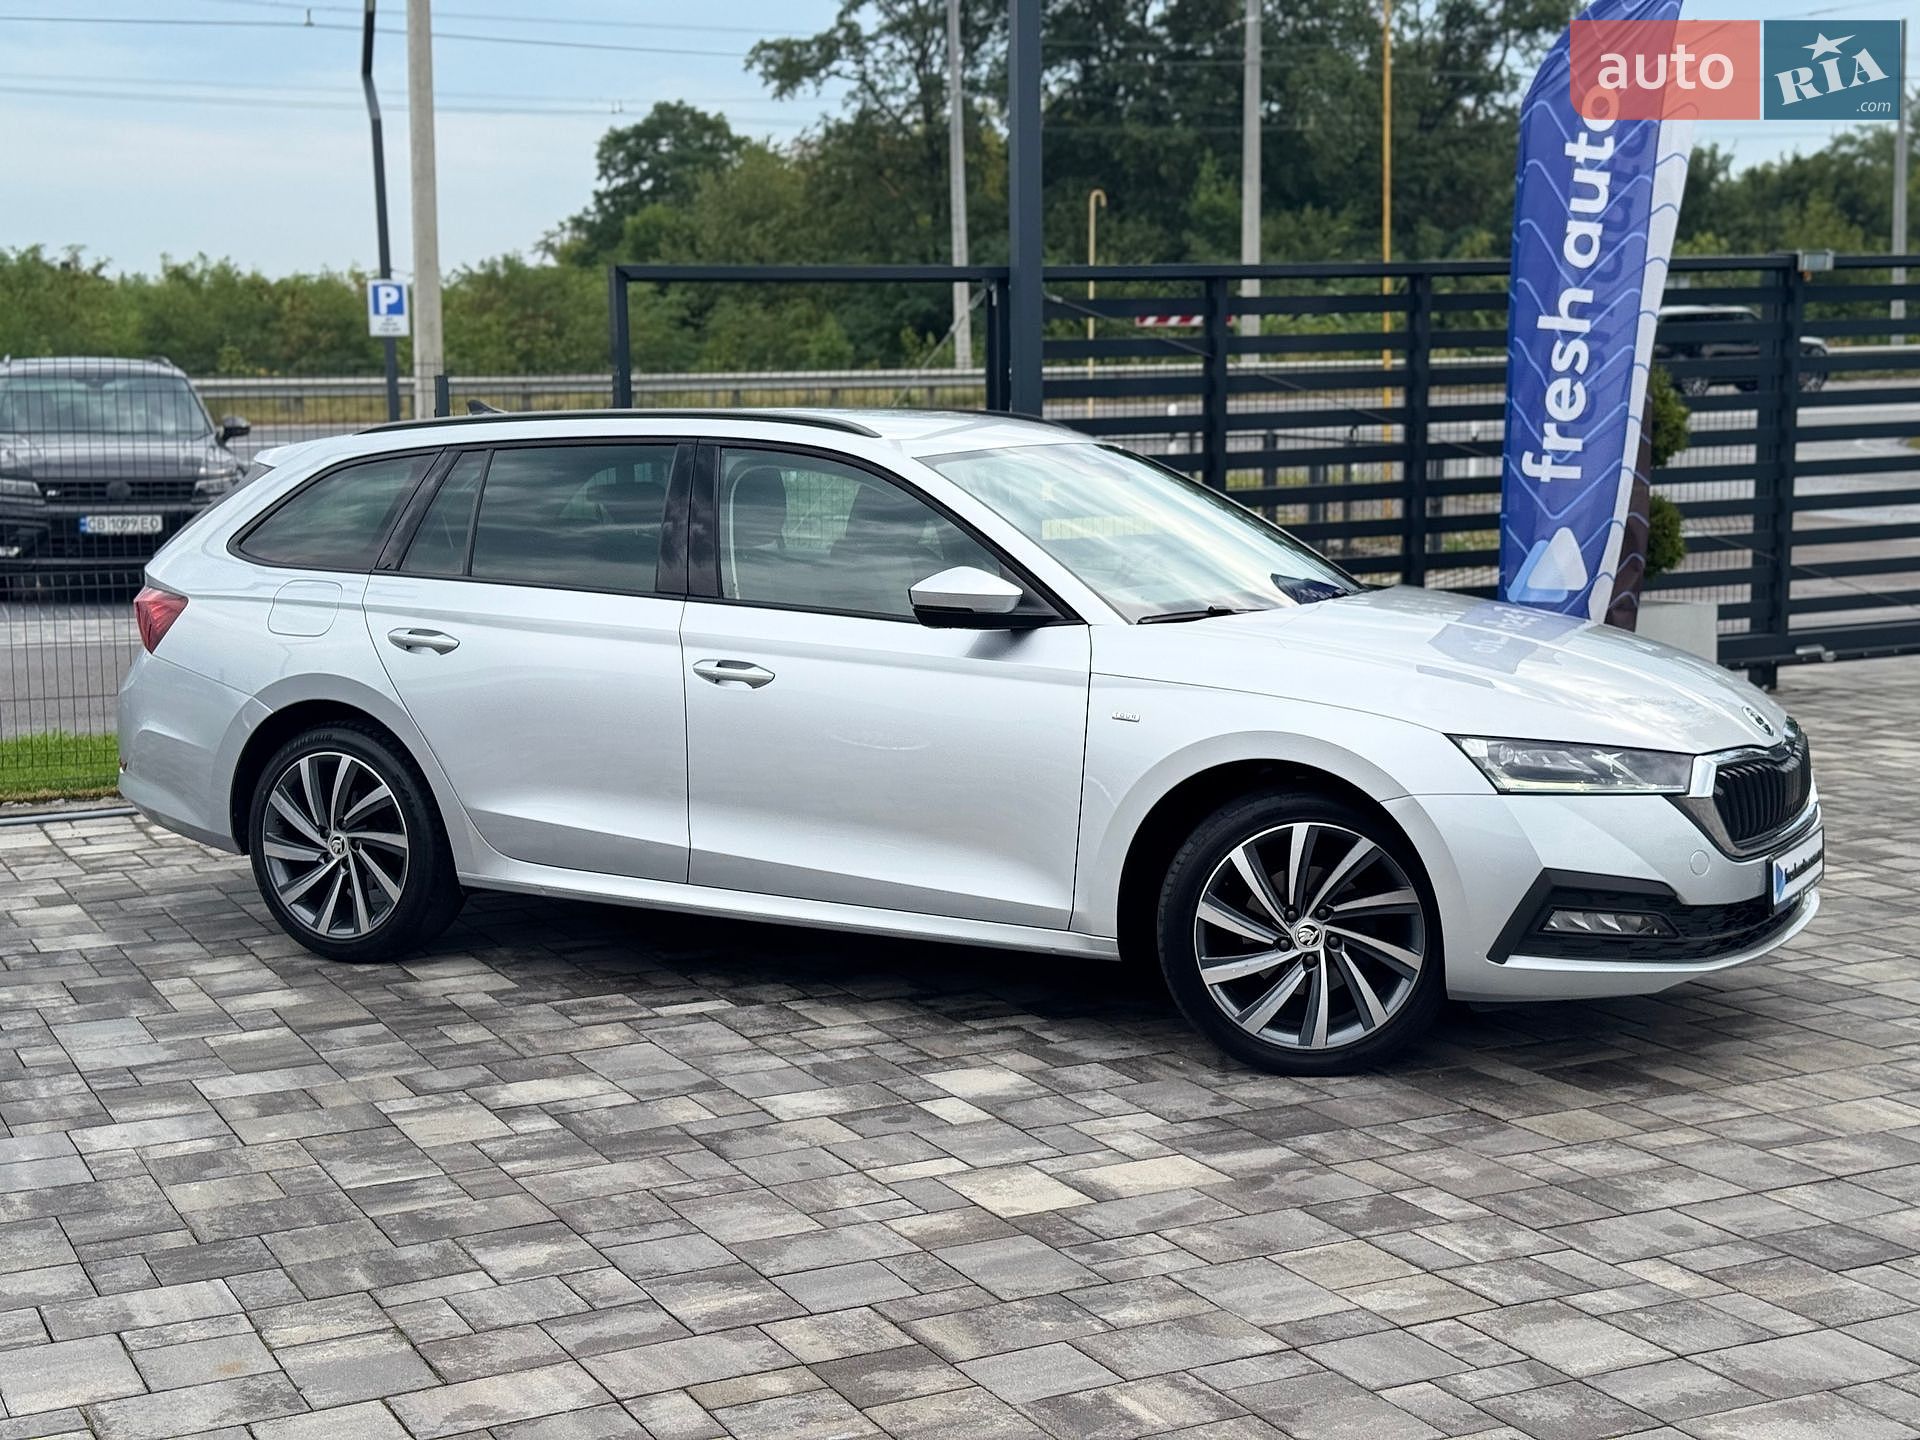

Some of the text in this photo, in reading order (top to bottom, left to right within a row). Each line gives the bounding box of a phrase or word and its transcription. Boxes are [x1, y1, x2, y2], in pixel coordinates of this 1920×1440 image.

[378, 285, 400, 315] P
[1521, 84, 1620, 484] fresh auto
